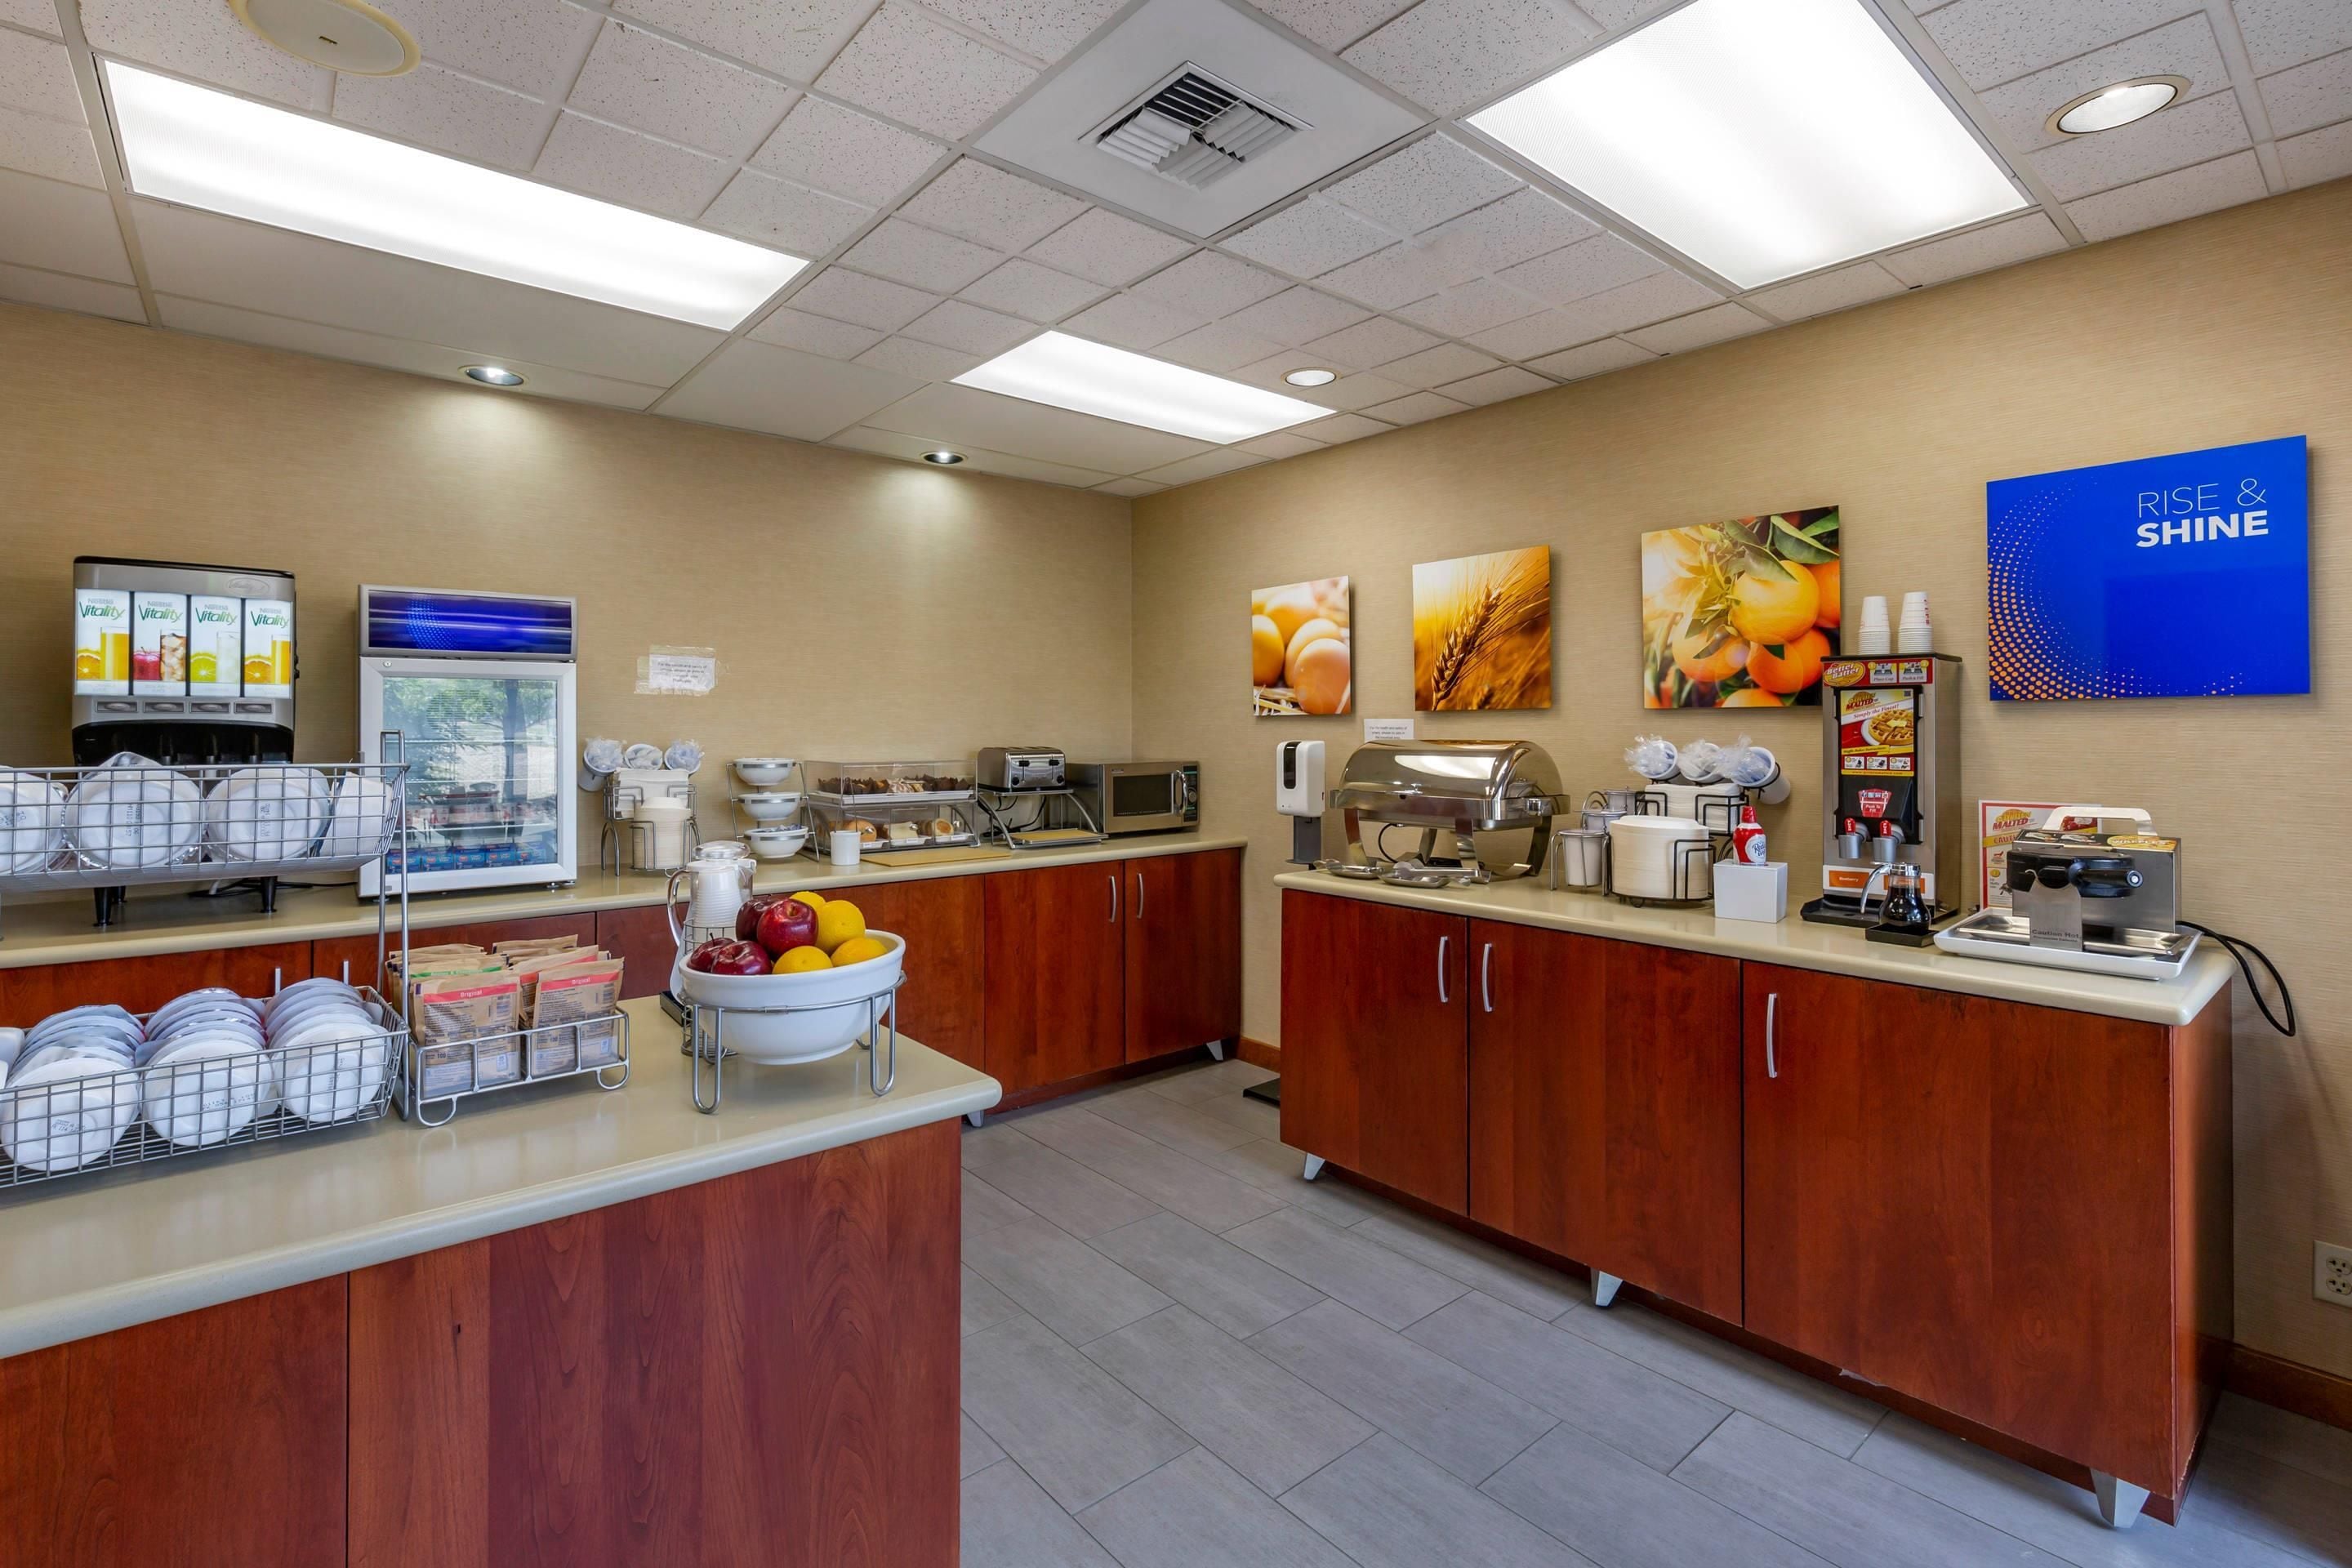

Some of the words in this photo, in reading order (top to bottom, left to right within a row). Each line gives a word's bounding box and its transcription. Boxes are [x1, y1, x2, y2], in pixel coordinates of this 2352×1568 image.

[2138, 483, 2221, 519] RISE
[2237, 478, 2266, 506] &
[2136, 510, 2269, 548] SHINE
[79, 600, 125, 620] Vitality
[138, 604, 183, 623] Vitality
[195, 607, 238, 626] Vitality
[251, 610, 289, 629] Vitality
[1827, 663, 1855, 675] Better
[1833, 667, 1860, 679] Batter
[1846, 698, 1873, 710] MALTED
[1854, 710, 1871, 719] Simply
[1993, 817, 2029, 831] MALTED
[1993, 834, 2016, 844] CAUTI
[572, 977, 590, 985] Original
[460, 990, 483, 998] Original
